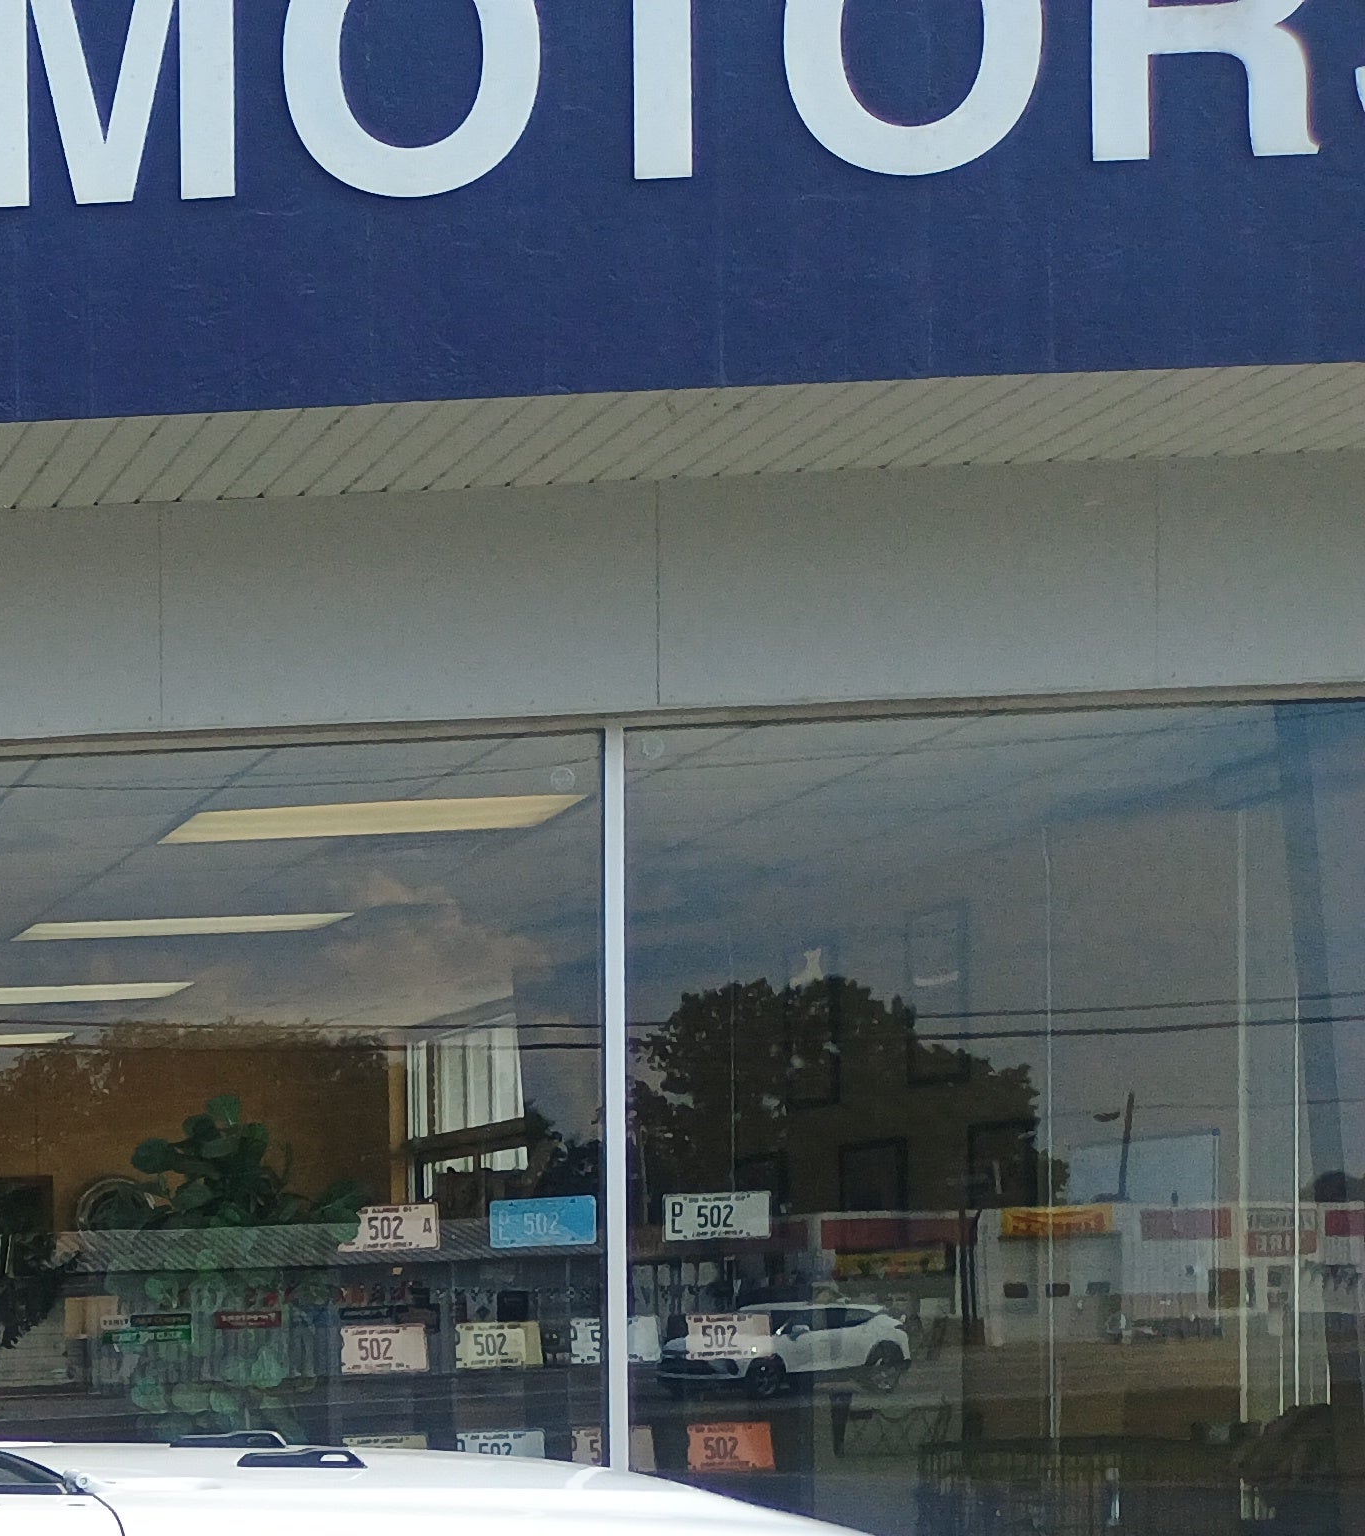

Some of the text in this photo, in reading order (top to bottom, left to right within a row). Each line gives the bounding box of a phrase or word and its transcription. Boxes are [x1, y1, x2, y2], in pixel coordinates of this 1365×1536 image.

[367, 1215, 405, 1241] 502
[523, 1212, 561, 1237] 502
[696, 1204, 734, 1229] 502
[472, 1332, 509, 1357] 502
[700, 1324, 739, 1349] 502
[357, 1337, 394, 1362] 502
[702, 1435, 740, 1461] 502
